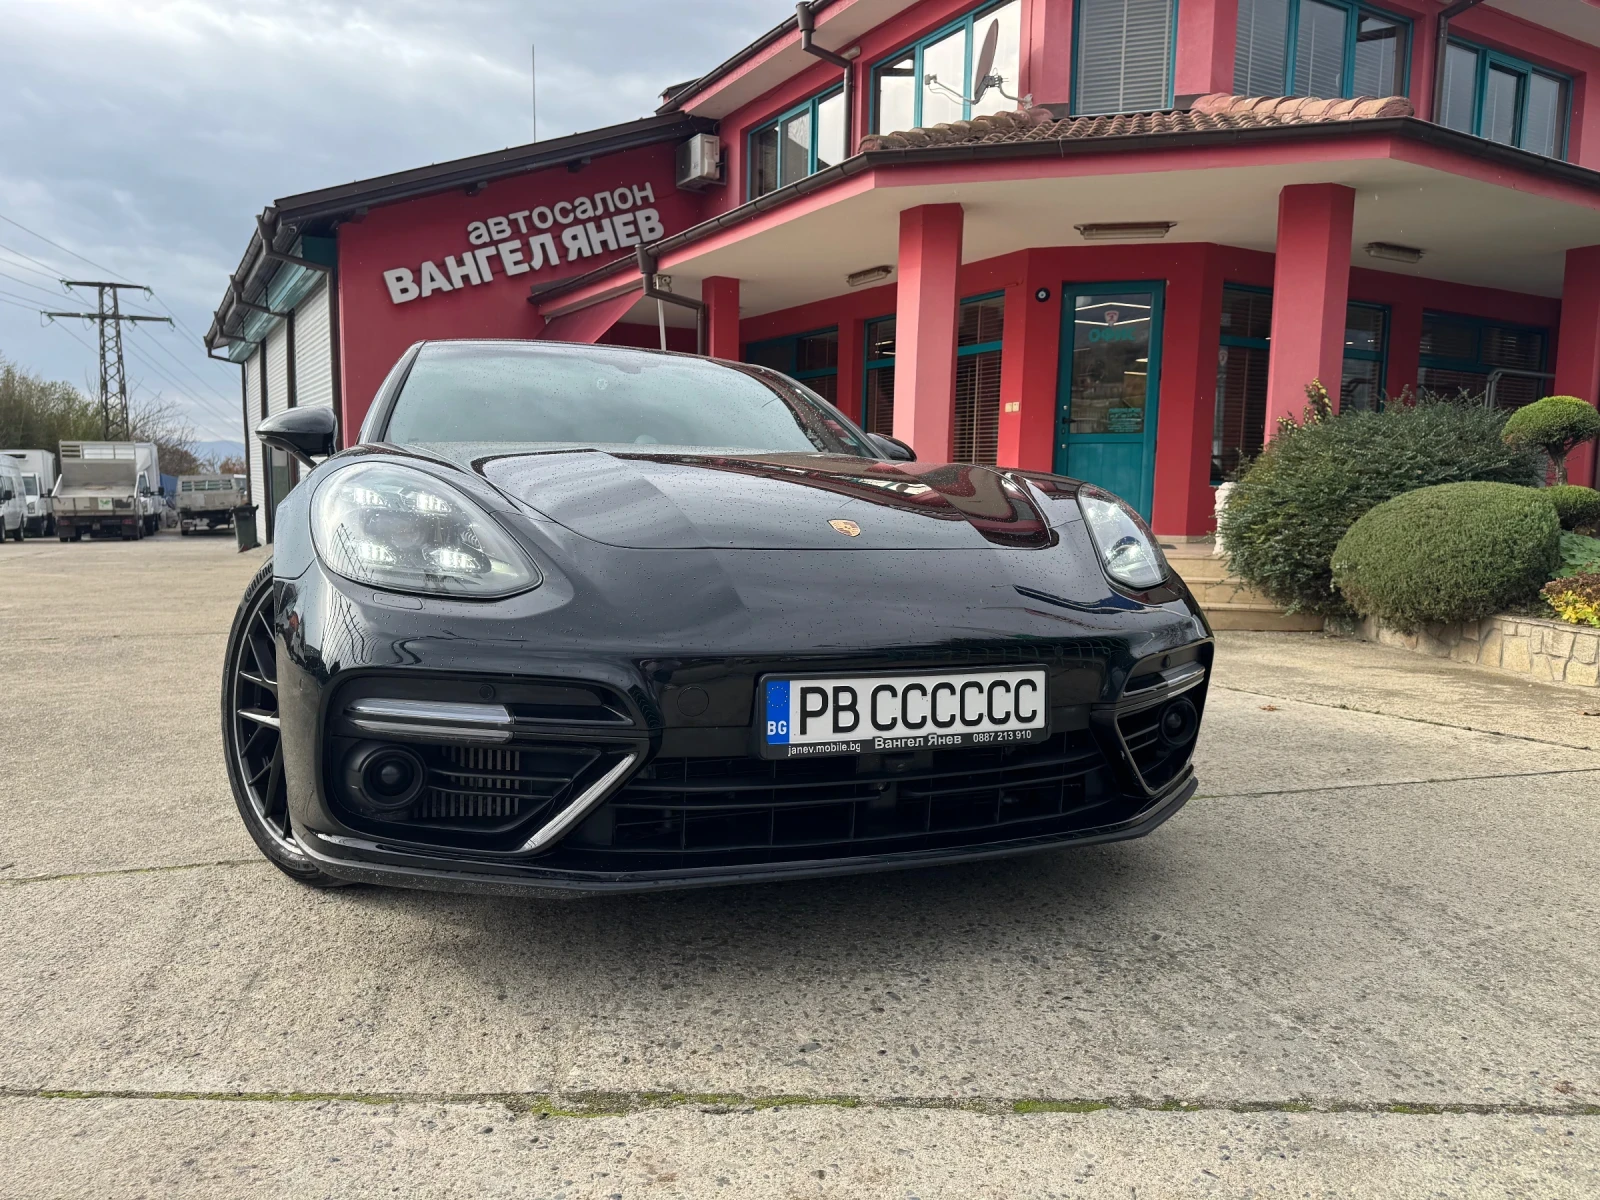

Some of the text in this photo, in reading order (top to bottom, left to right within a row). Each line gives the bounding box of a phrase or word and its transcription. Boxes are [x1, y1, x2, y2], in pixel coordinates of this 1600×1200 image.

[467, 182, 655, 245] автосалон
[383, 208, 665, 304] ВАНГЕЛ ЯНЕВ
[767, 720, 787, 735] BG
[874, 734, 962, 749] Вангел Янев
[973, 730, 1032, 743] 0887 213 910
[788, 742, 861, 757] janev.mobile.bg
